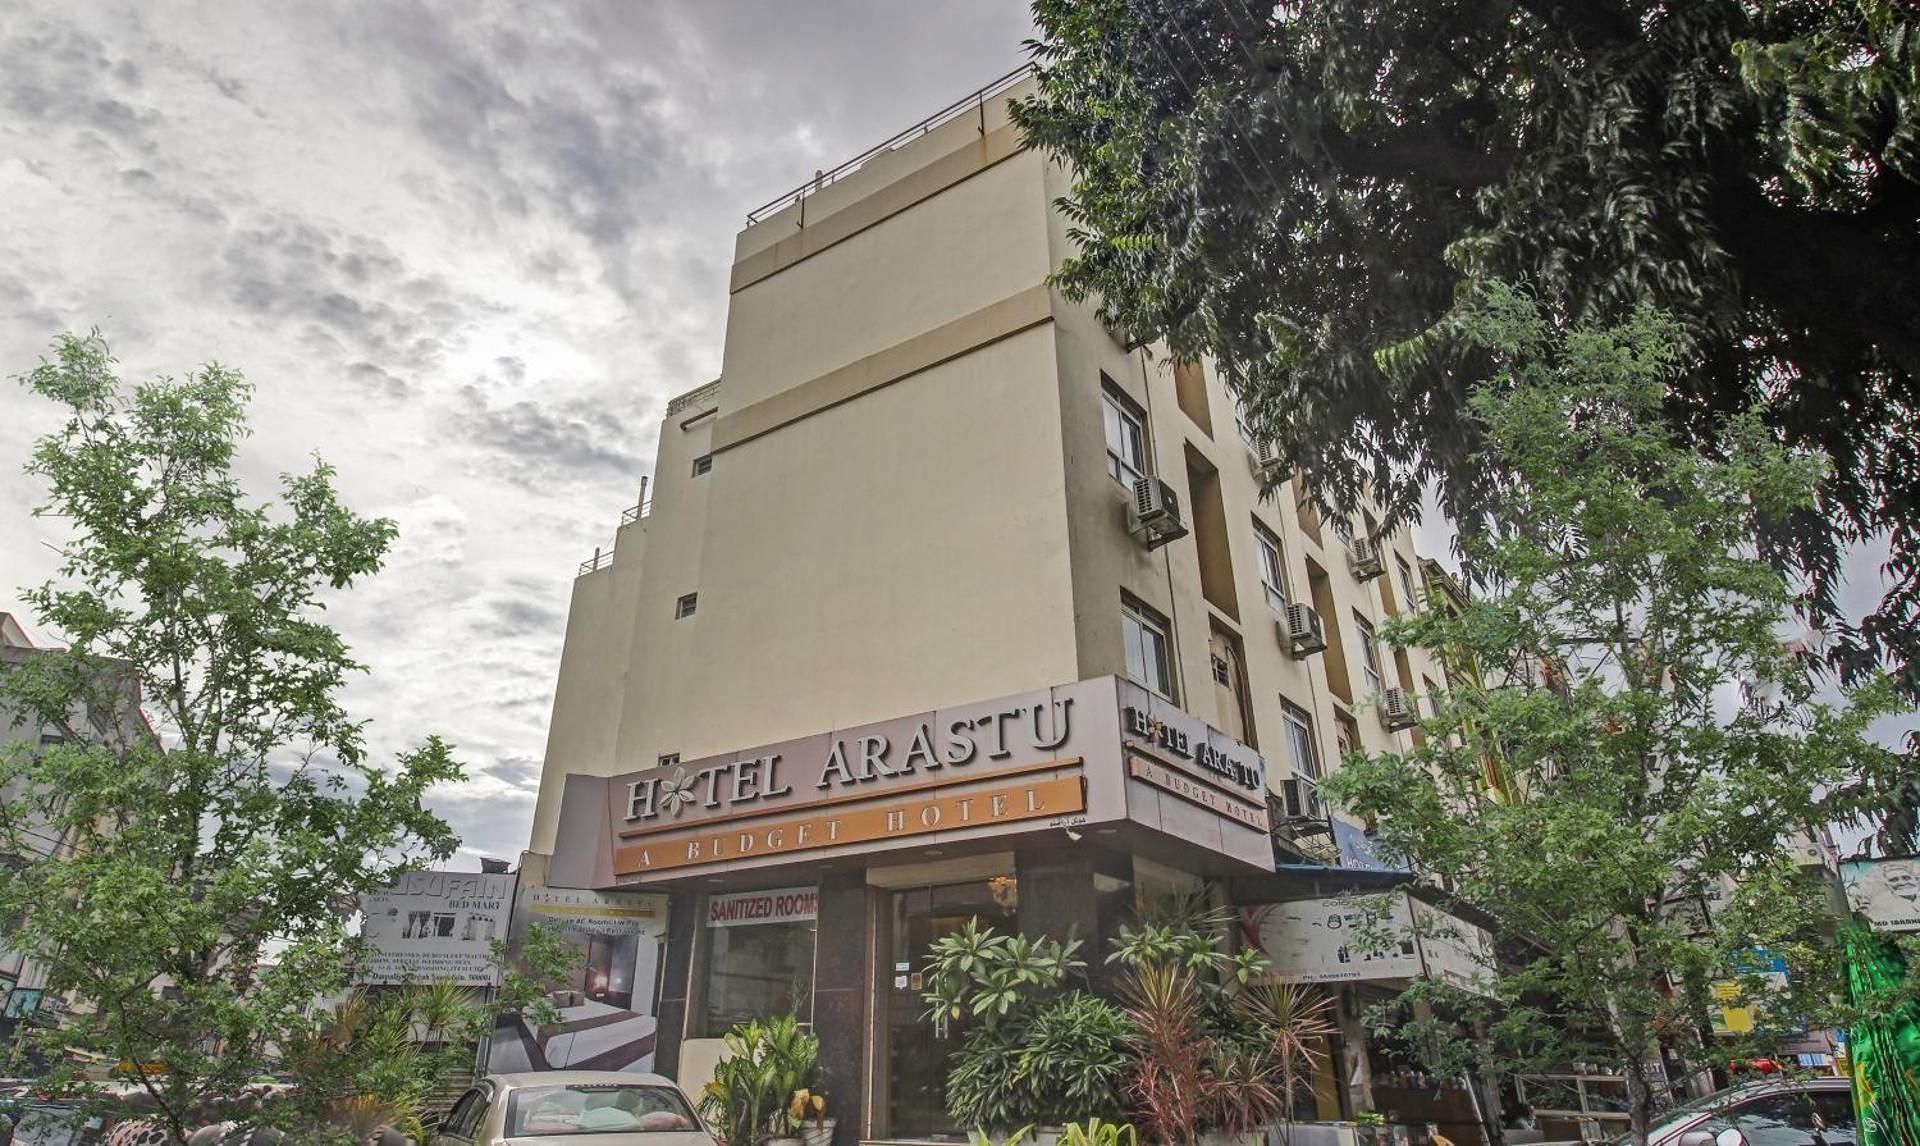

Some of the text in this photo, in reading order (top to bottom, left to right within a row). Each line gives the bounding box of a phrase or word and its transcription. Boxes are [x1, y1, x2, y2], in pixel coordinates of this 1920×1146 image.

[815, 698, 1074, 789] ARASTU
[1164, 773, 1216, 805] BUDGET
[638, 789, 1045, 868] A BUDGET HOTEL
[711, 896, 773, 921] SANITIZED
